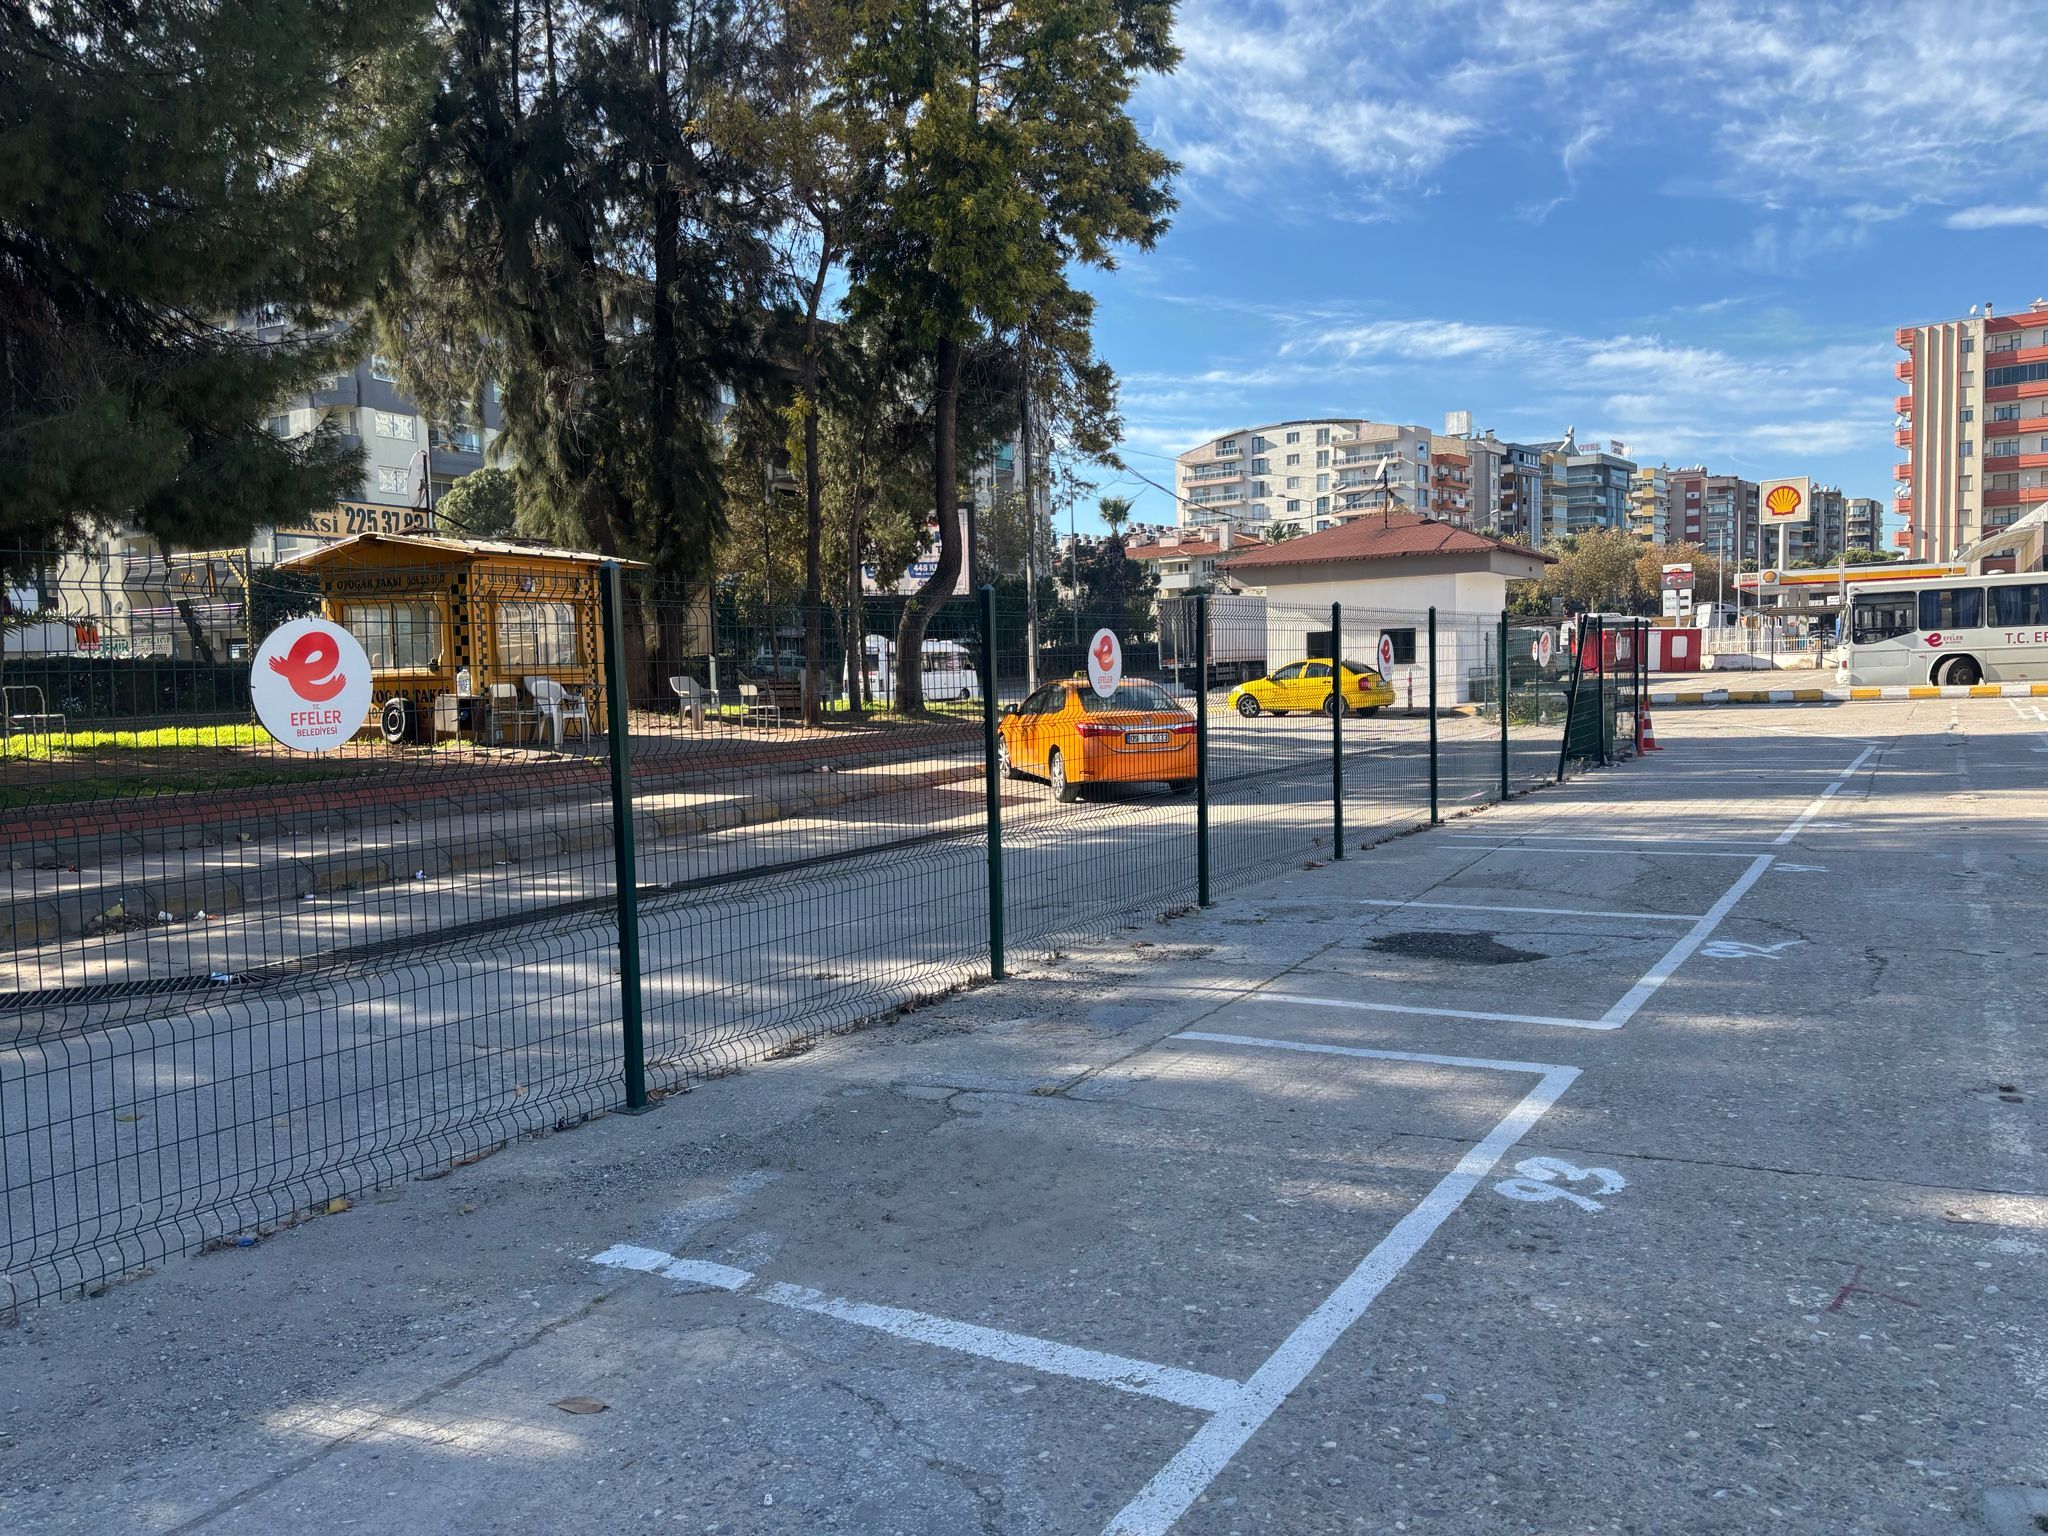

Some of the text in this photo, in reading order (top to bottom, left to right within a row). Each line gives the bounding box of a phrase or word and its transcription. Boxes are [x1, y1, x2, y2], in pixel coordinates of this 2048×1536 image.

[345, 507, 378, 535] 225
[381, 510, 400, 534] 37
[2004, 632, 2030, 644] T.C.
[290, 710, 342, 727] EFELER
[296, 726, 338, 737] BELEDİYESİ
